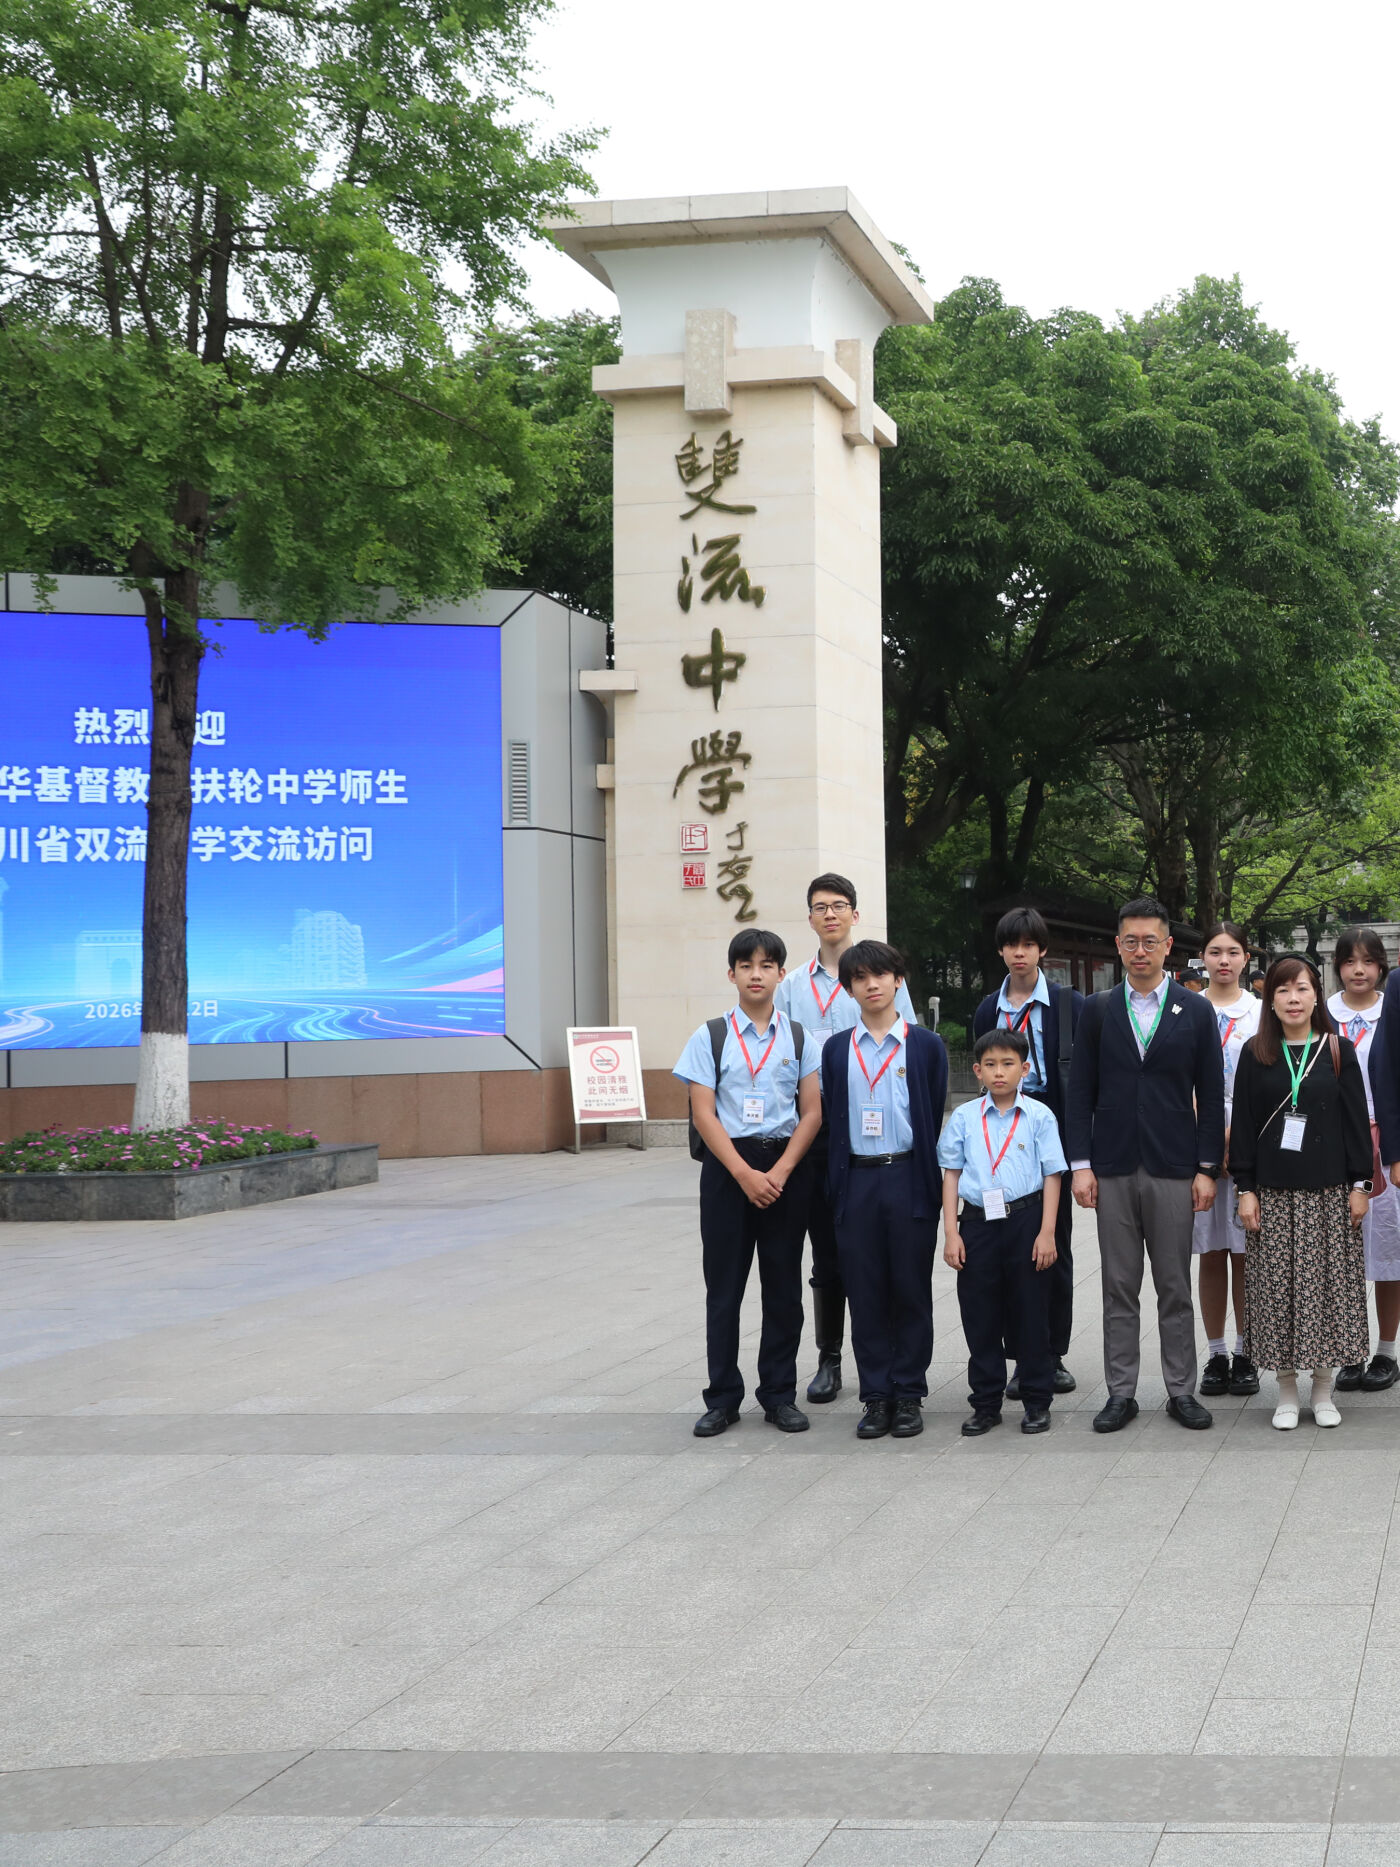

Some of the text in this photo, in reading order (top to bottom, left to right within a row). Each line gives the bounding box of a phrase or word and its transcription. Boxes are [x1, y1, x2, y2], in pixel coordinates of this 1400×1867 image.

[74, 707, 225, 746] 热烈迎
[0, 766, 408, 805] 华基督教扶轮中学师生
[0, 825, 373, 863] 川省双流学交流访问
[84, 1000, 218, 1019] 2026年2日
